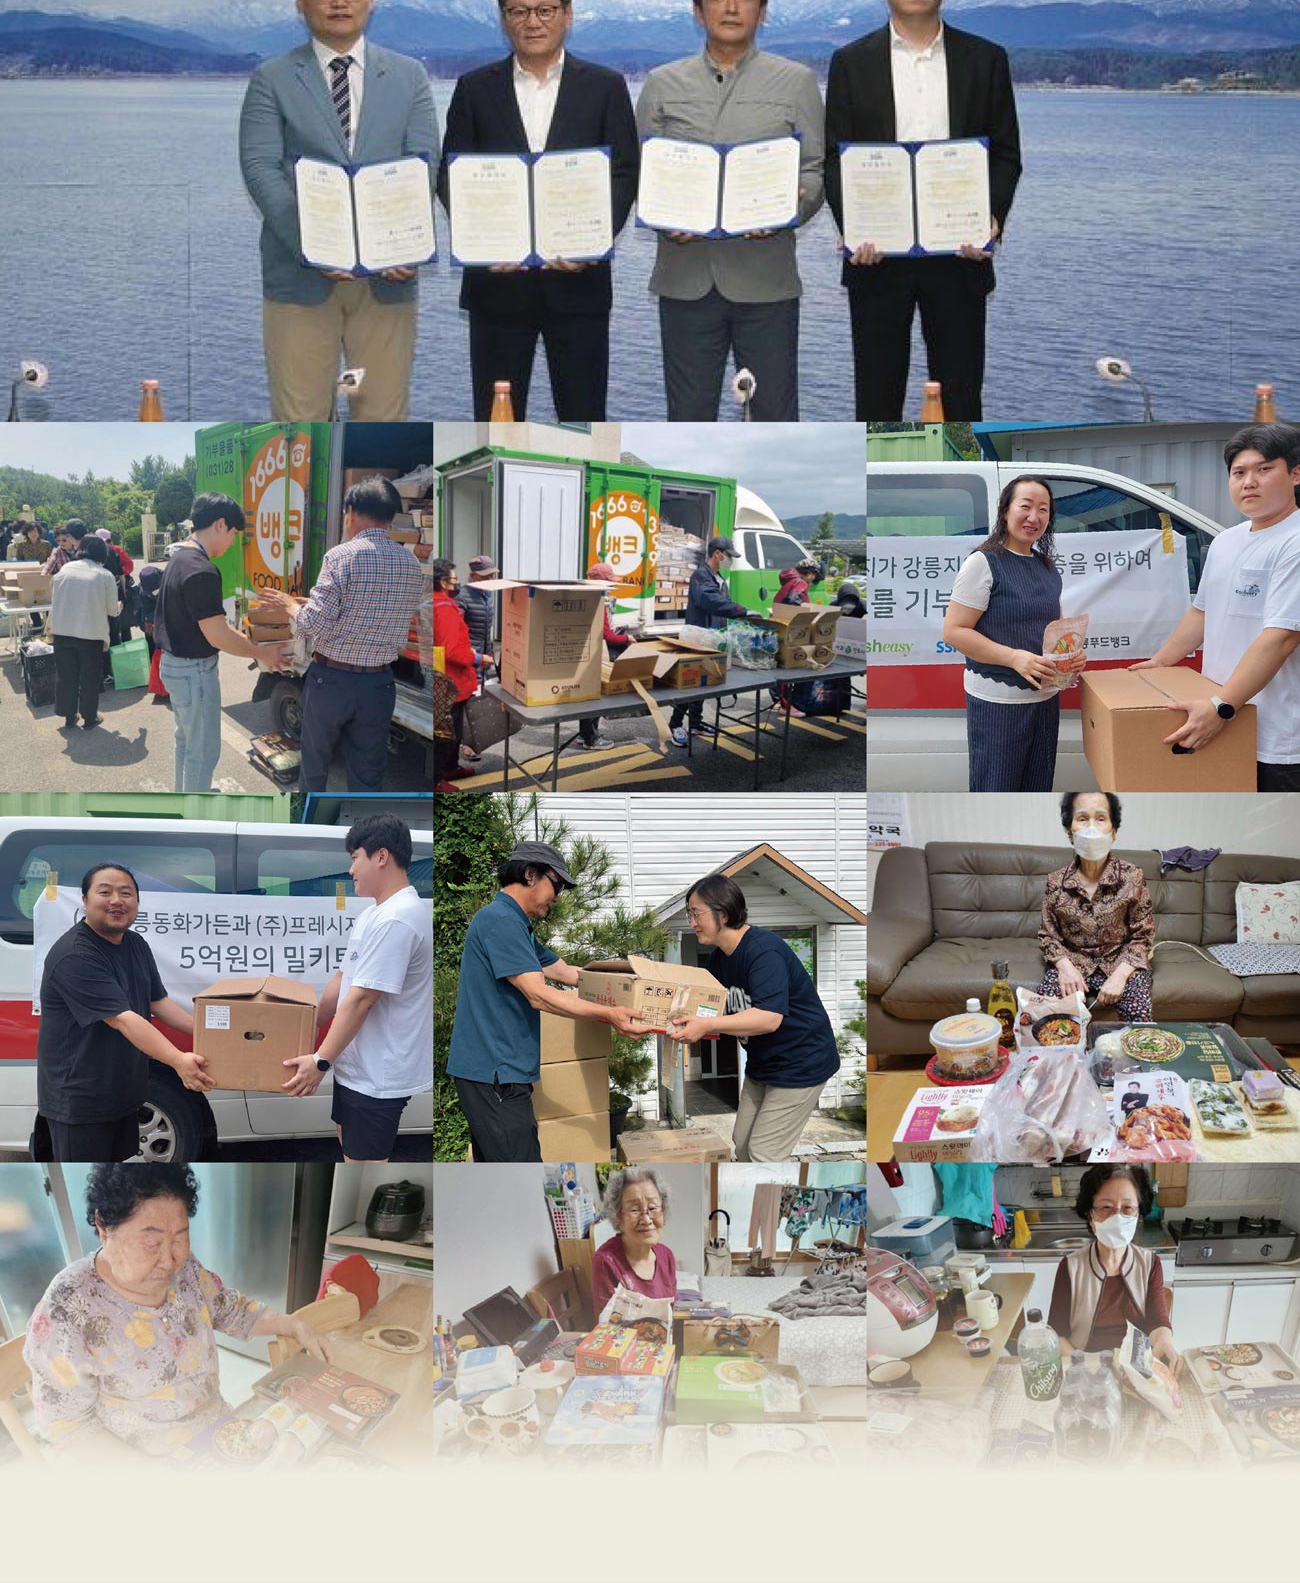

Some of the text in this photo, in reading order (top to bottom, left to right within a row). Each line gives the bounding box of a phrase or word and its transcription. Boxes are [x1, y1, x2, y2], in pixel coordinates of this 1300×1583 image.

[903, 547, 1153, 579] 강릉지 위하여
[253, 571, 282, 592] FOOD
[179, 945, 275, 973] 5억원의
[1029, 1362, 1058, 1399] Chilsung
